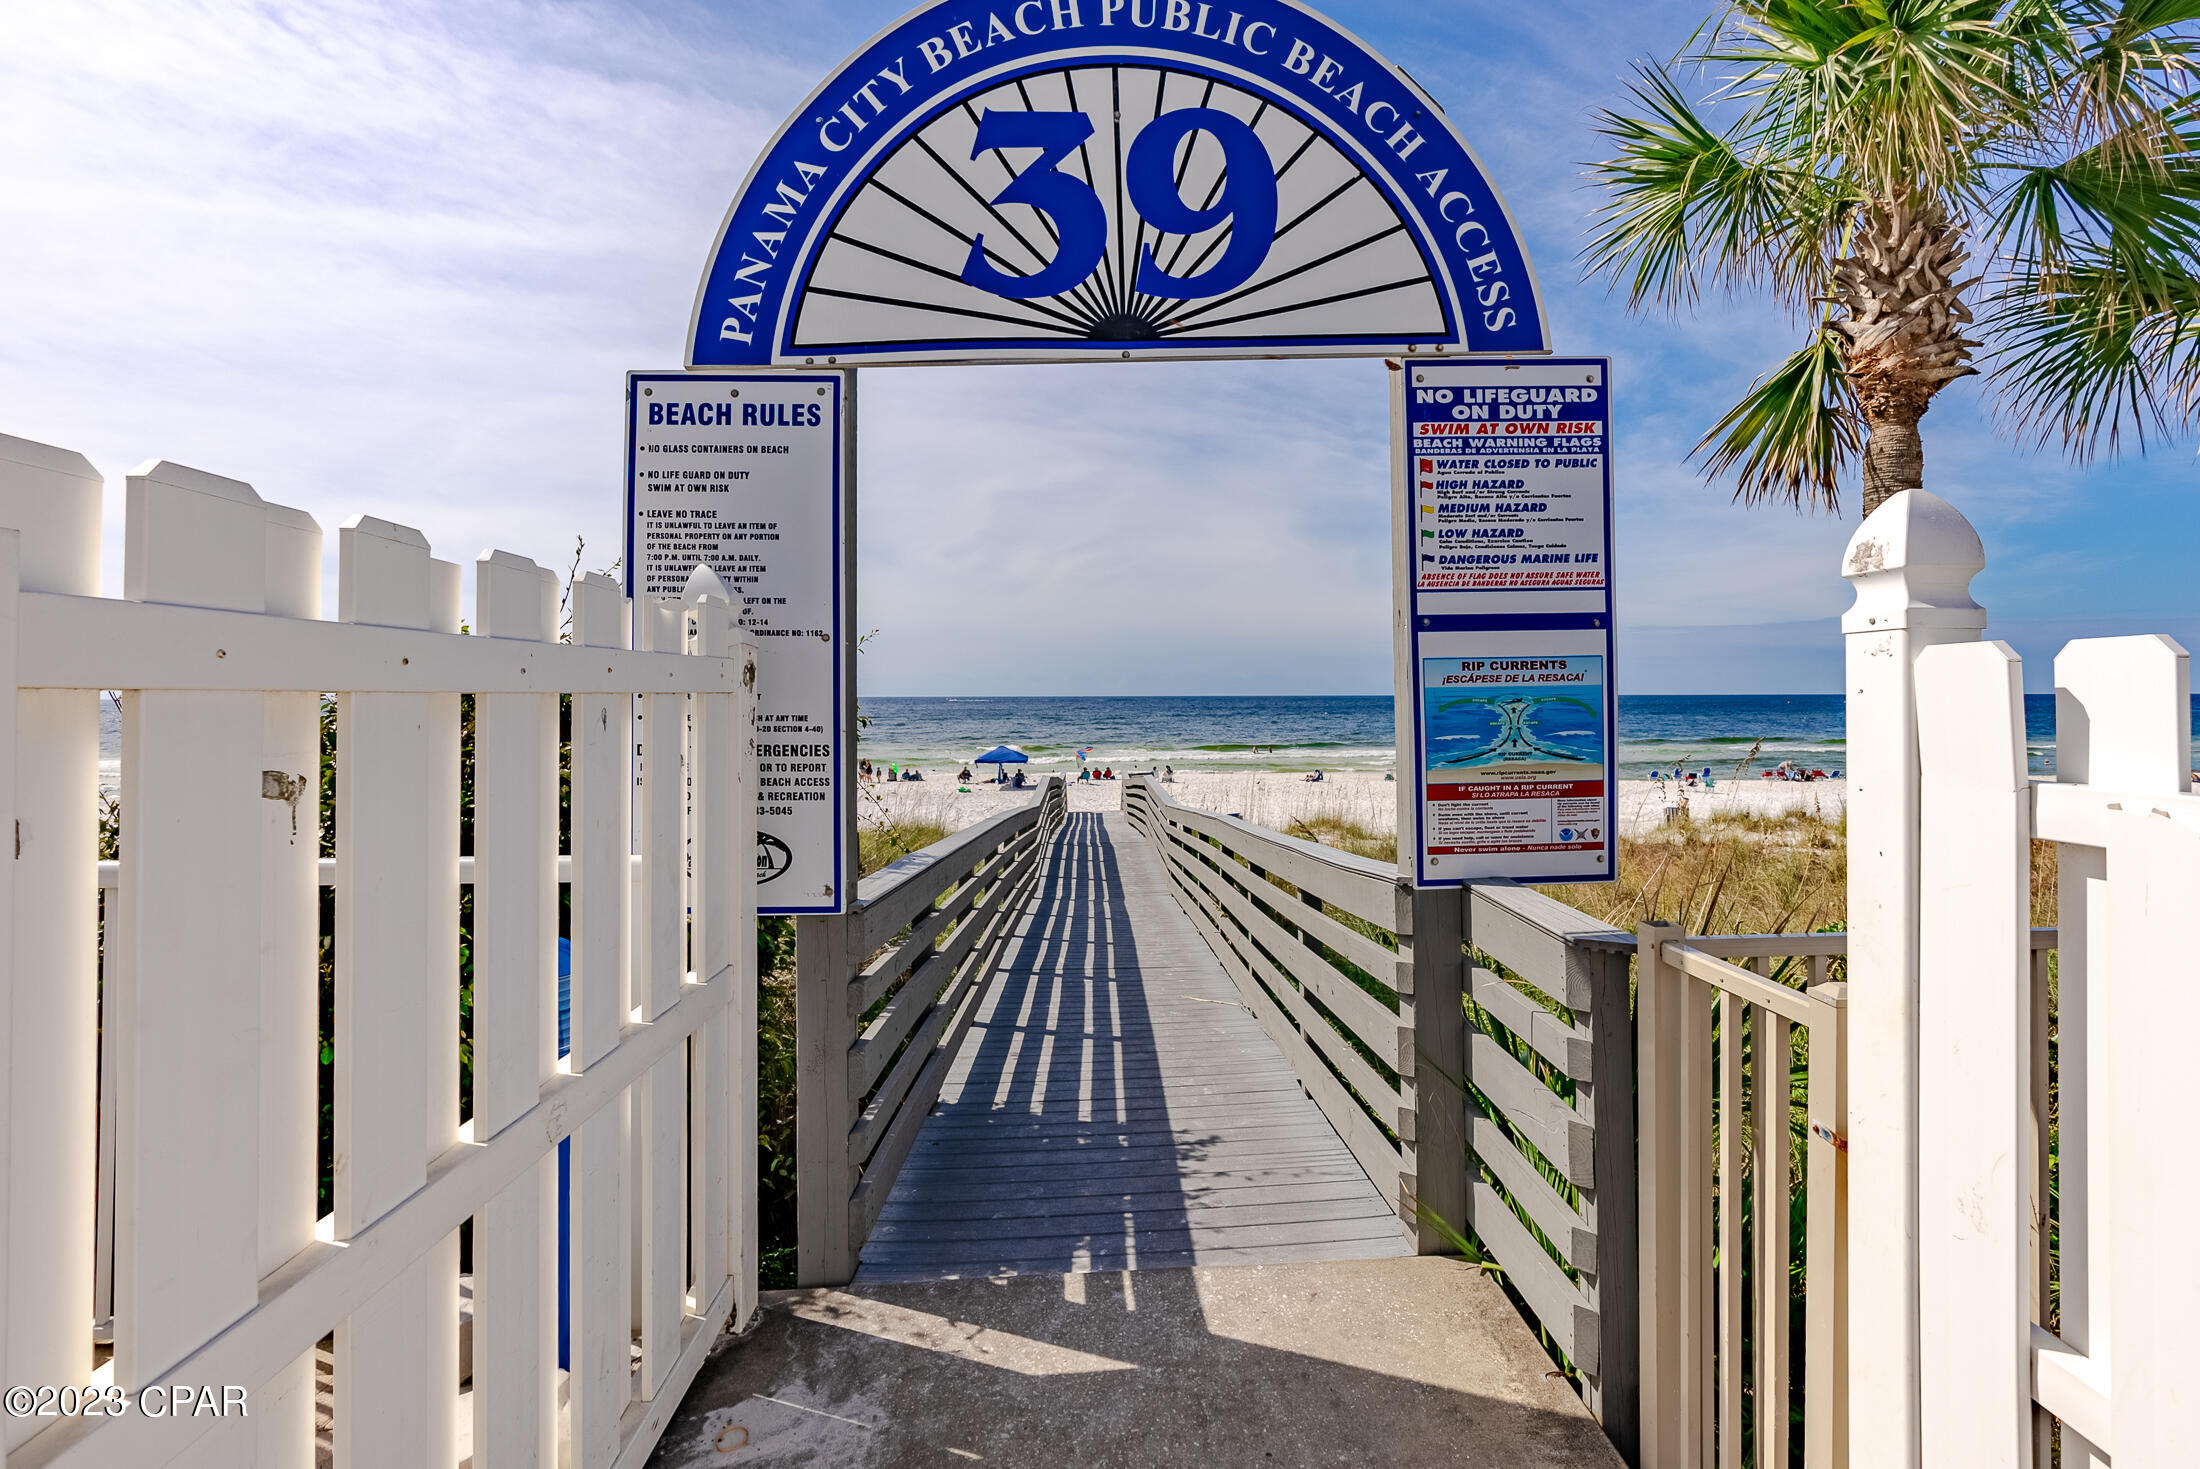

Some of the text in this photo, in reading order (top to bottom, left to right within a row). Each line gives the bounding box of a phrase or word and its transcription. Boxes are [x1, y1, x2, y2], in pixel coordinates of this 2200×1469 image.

[720, 0, 1518, 346] PANAMA CITY BEACH PUBLIC BEACH ACCESS
[960, 107, 1278, 300] 39
[1416, 388, 1597, 404] NO LIFEGUARD
[649, 402, 821, 427] BEACH RULES
[1452, 404, 1562, 420] ON DUTY
[1420, 422, 1596, 435] SWIM AT OWN RISK
[1413, 437, 1601, 448] BEACH WARNING FLAGS
[648, 444, 789, 454] NO GLASS CONTAINERS ON BEACH
[1437, 458, 1597, 469] WATER CLOSED TO PUBLIC
[648, 470, 750, 480] NO LIFE GUARD ON DUTY
[648, 484, 729, 492] SWIM AT OWN RISK
[1436, 479, 1524, 490] HIGH HAZARD
[1438, 503, 1547, 513] MEDIUM HAZARD
[647, 510, 717, 519] LEAVE NO TRACE
[714, 522, 736, 530] LEAVE
[737, 522, 747, 530] AN
[749, 522, 766, 530] ITEM
[1438, 528, 1524, 539] LOW HAZARD
[739, 554, 761, 562] DAILY.
[1439, 553, 1598, 564] DANGEROUS MARINE LIFE
[655, 564, 662, 572] IS
[1468, 572, 1487, 580] FLAG
[1488, 572, 1509, 580] DOES
[1555, 571, 1574, 579] SAFE
[773, 597, 786, 605] THE
[1462, 660, 1567, 671] RIP CURRENTS
[1442, 673, 1584, 685] ¡ESCÁPESE DE LA RESACA!
[764, 714, 774, 722] AT
[773, 725, 803, 733] SECTION
[759, 763, 826, 772] OR TO REPORT
[760, 777, 830, 787] BEACH ACCESS
[768, 792, 825, 801] RECREATION
